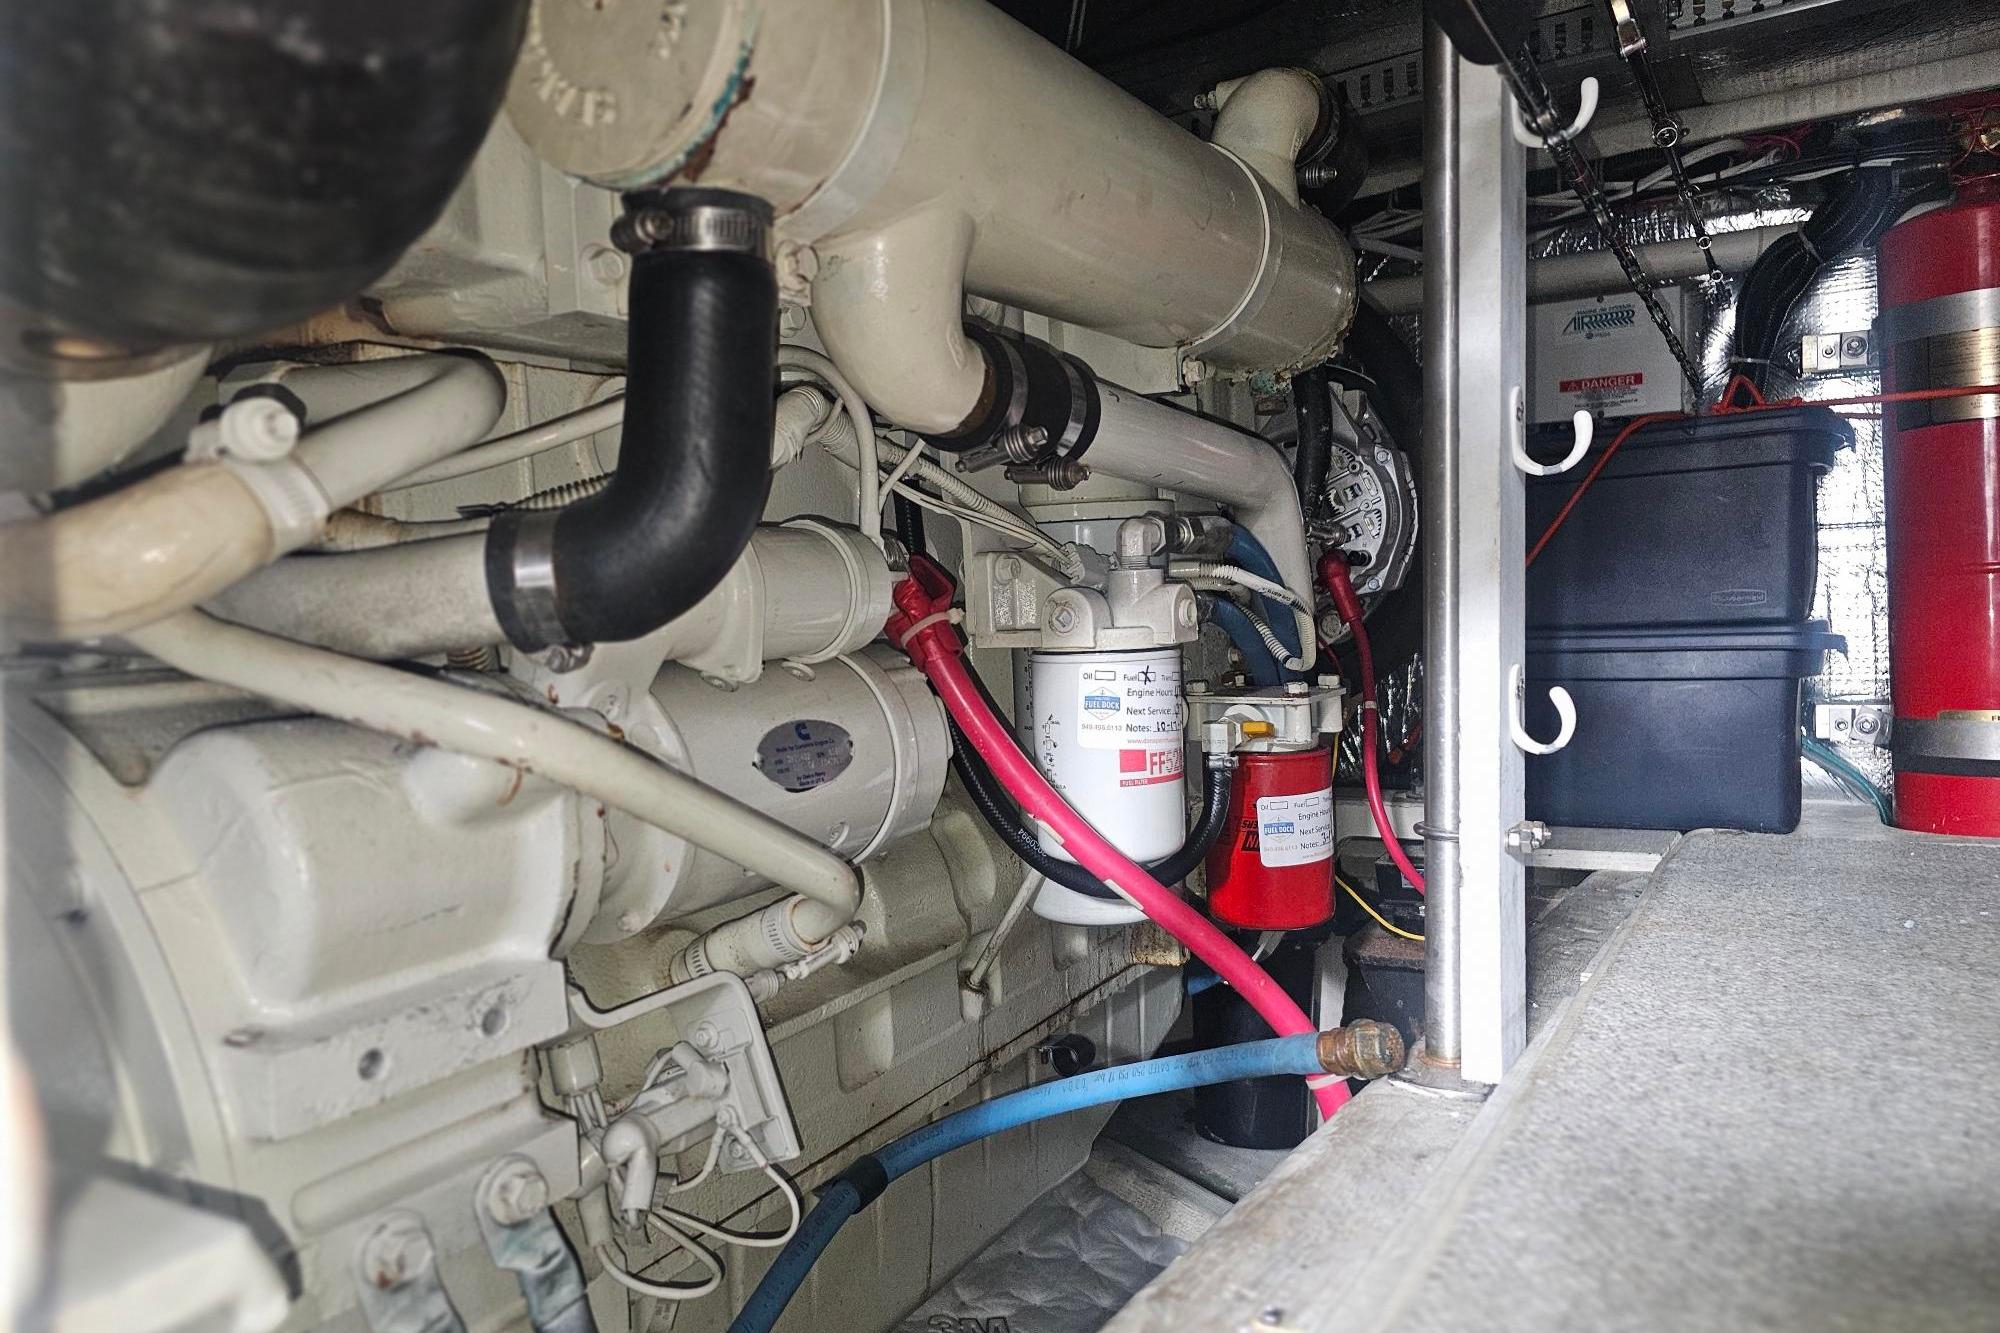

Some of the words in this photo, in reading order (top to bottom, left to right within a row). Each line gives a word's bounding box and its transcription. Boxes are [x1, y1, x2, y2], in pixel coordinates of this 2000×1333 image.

[1581, 375, 1635, 389] DANGER
[1082, 672, 1094, 680] Oil
[1123, 673, 1138, 681] Fuel
[1127, 687, 1155, 698] Engine
[1085, 700, 1101, 709] FUEL
[1102, 700, 1120, 710] DOCK
[1126, 706, 1146, 715] Next
[1126, 723, 1152, 732] Notes:
[1297, 811, 1318, 821] Engine
[1264, 827, 1278, 835] FUEL
[1279, 825, 1295, 834] DOCK
[1299, 827, 1315, 837] Next
